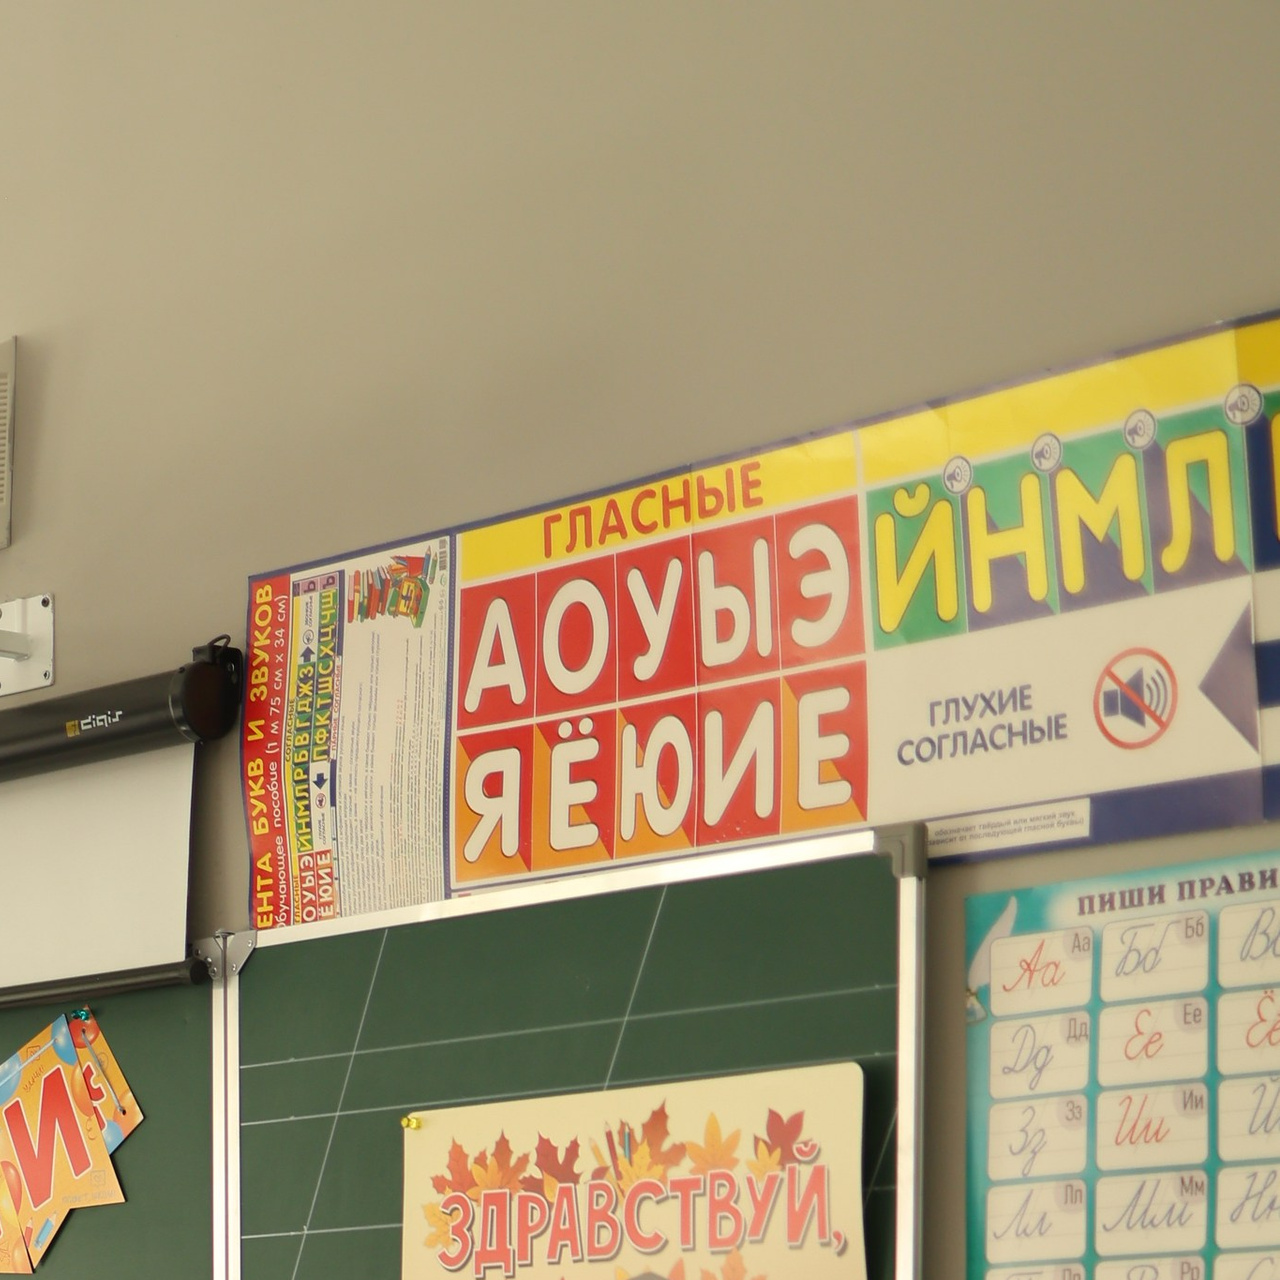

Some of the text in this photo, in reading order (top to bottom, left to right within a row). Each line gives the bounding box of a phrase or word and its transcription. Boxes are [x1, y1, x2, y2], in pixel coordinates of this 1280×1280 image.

[542, 462, 764, 558] ГЛАСНЫЕ
[249, 584, 273, 702] ЗВУКОВ
[274, 628, 285, 648] 34
[269, 697, 281, 717] 75
[928, 685, 1034, 728] ГЛУХИЕ
[80, 710, 122, 731] digis
[247, 719, 265, 742] И
[896, 713, 1068, 768] СОГЛАСНЫЕ
[247, 757, 270, 835] БУКВ
[266, 761, 282, 828] пособие
[1077, 884, 1166, 917] ПИШИ
[1184, 916, 1205, 939] Бб
[1071, 933, 1091, 953] Аа
[1002, 939, 1066, 992] Аа
[1183, 1003, 1202, 1024] Ее
[1066, 1018, 1089, 1042] Дд
[1124, 1009, 1164, 1063] Ее
[1065, 1100, 1082, 1122] Зз
[1183, 1089, 1204, 1111] Ии
[1064, 1184, 1082, 1206] Лл
[1180, 1175, 1205, 1197] Мм
[437, 1141, 848, 1280] ЗДРАВСТВУЙ,
